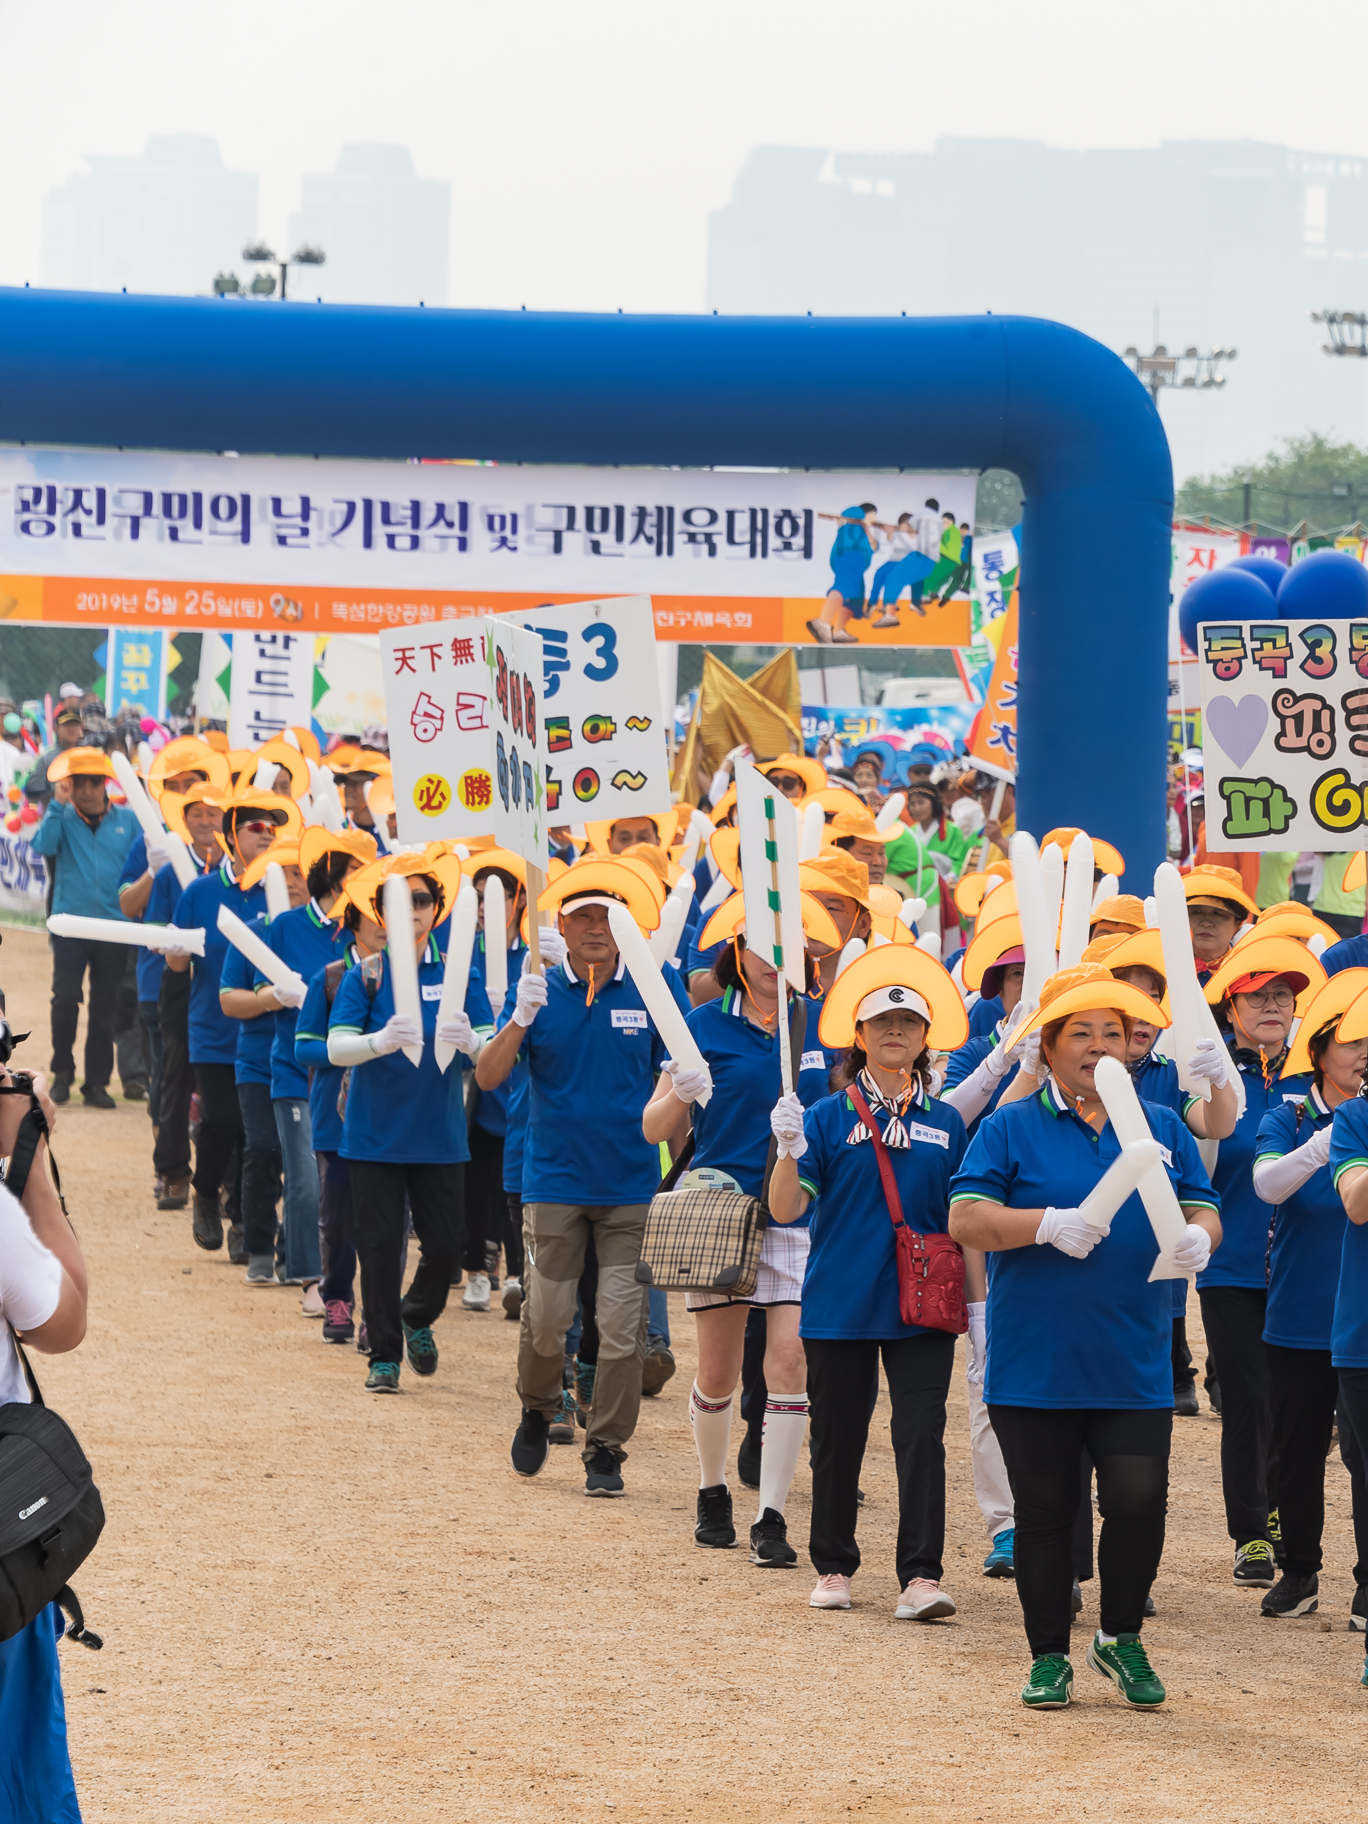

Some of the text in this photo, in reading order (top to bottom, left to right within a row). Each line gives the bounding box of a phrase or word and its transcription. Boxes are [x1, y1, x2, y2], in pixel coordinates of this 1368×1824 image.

[14, 483, 814, 561] 광진구민의 날 기념식 및 구민체육대회
[77, 591, 138, 613] 2019년
[144, 587, 177, 616] 5월
[184, 588, 263, 619] 25일(토)
[331, 601, 436, 625] 뚝섬한강공원
[393, 636, 487, 676] 天下無
[18, 1495, 50, 1521] Canon
